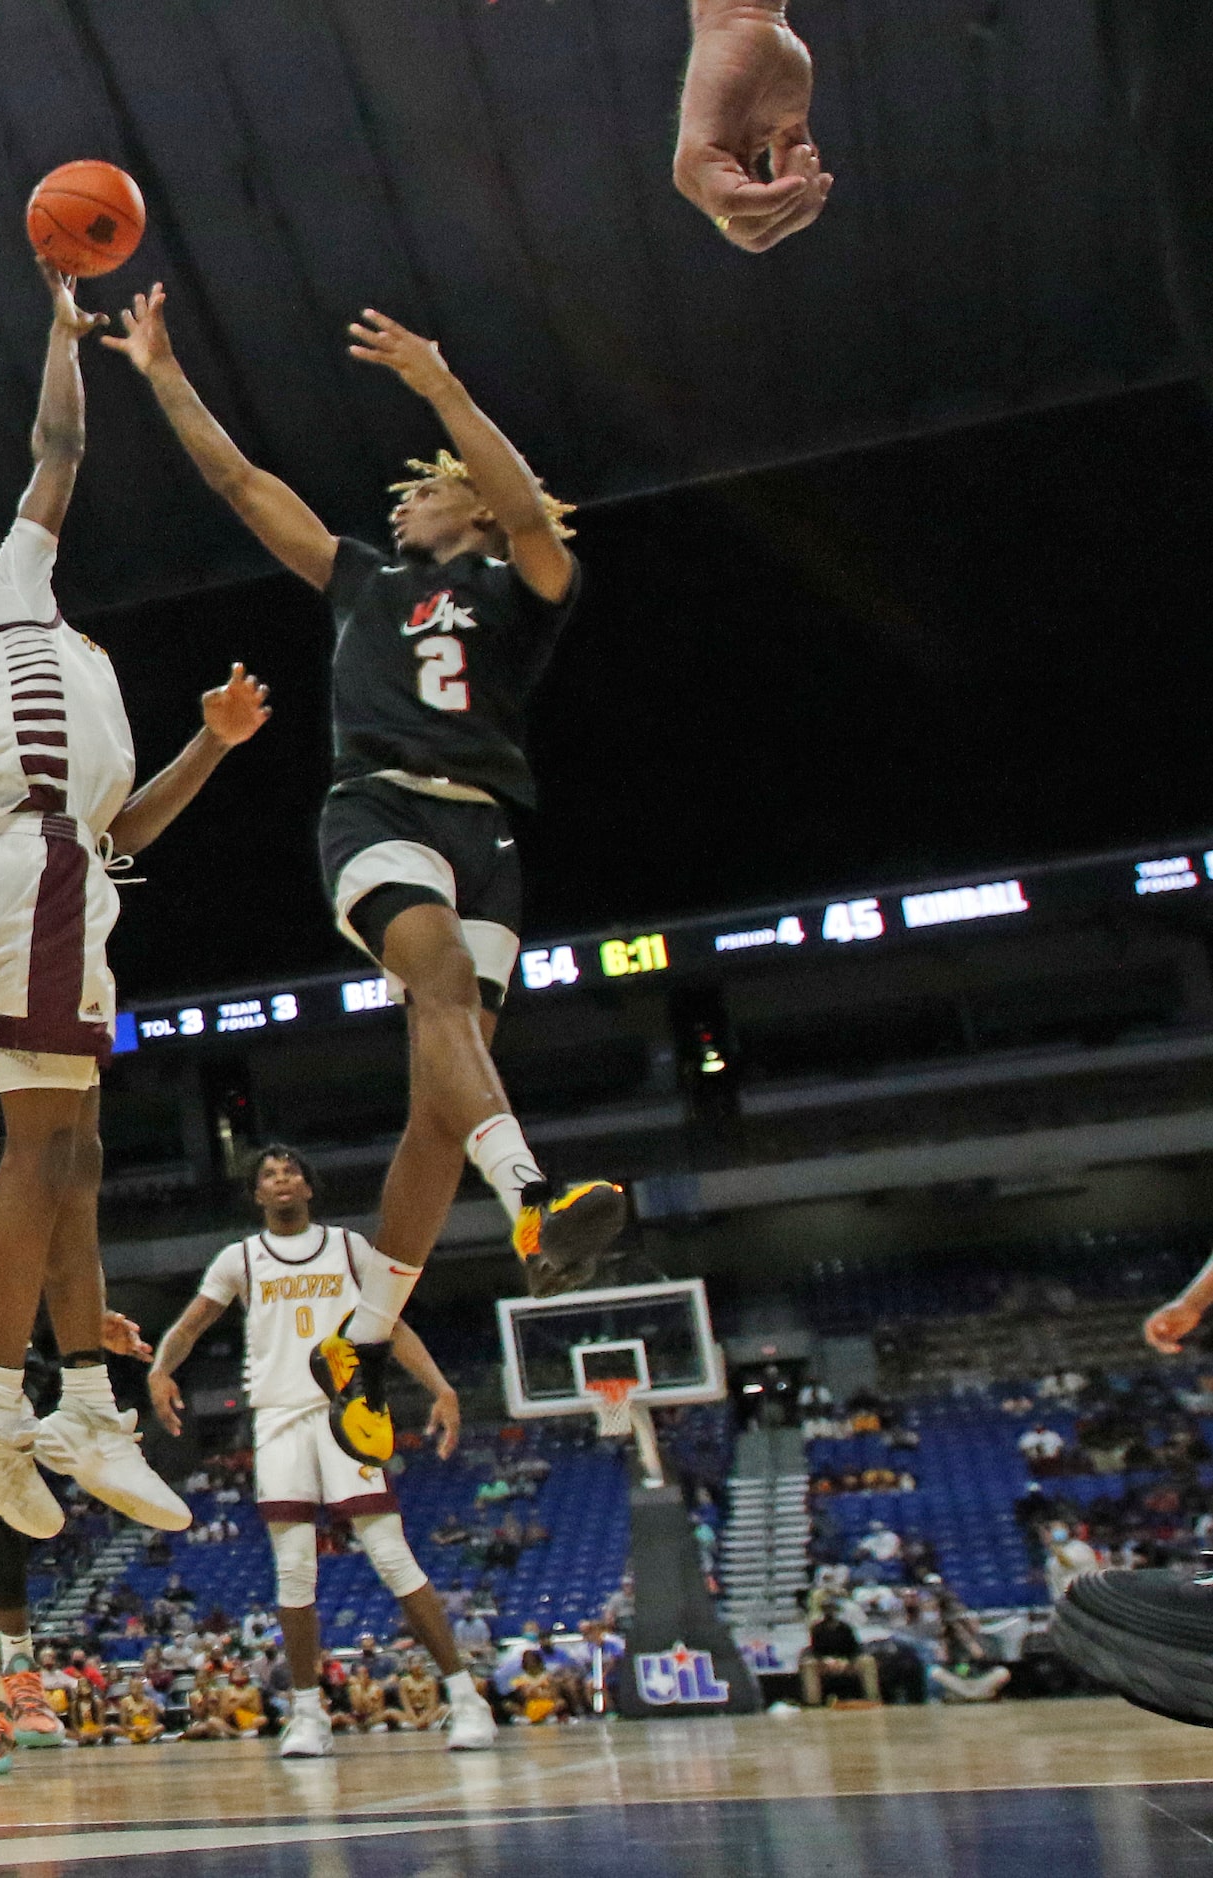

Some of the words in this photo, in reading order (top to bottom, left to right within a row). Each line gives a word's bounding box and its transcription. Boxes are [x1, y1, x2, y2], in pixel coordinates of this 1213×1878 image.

[414, 635, 470, 712] 2
[520, 945, 580, 989] 54
[600, 933, 670, 977] 6:11
[775, 916, 806, 945] 4
[822, 898, 886, 943] 45
[901, 880, 1030, 928] KIMBALL
[139, 1019, 177, 1038] TOL
[177, 1007, 204, 1035] 3
[216, 1013, 267, 1033] FOULS
[271, 993, 298, 1021] 3
[218, 1000, 262, 1018] TEAM
[260, 1273, 344, 1304] WOLVES
[295, 1306, 315, 1338] 0
